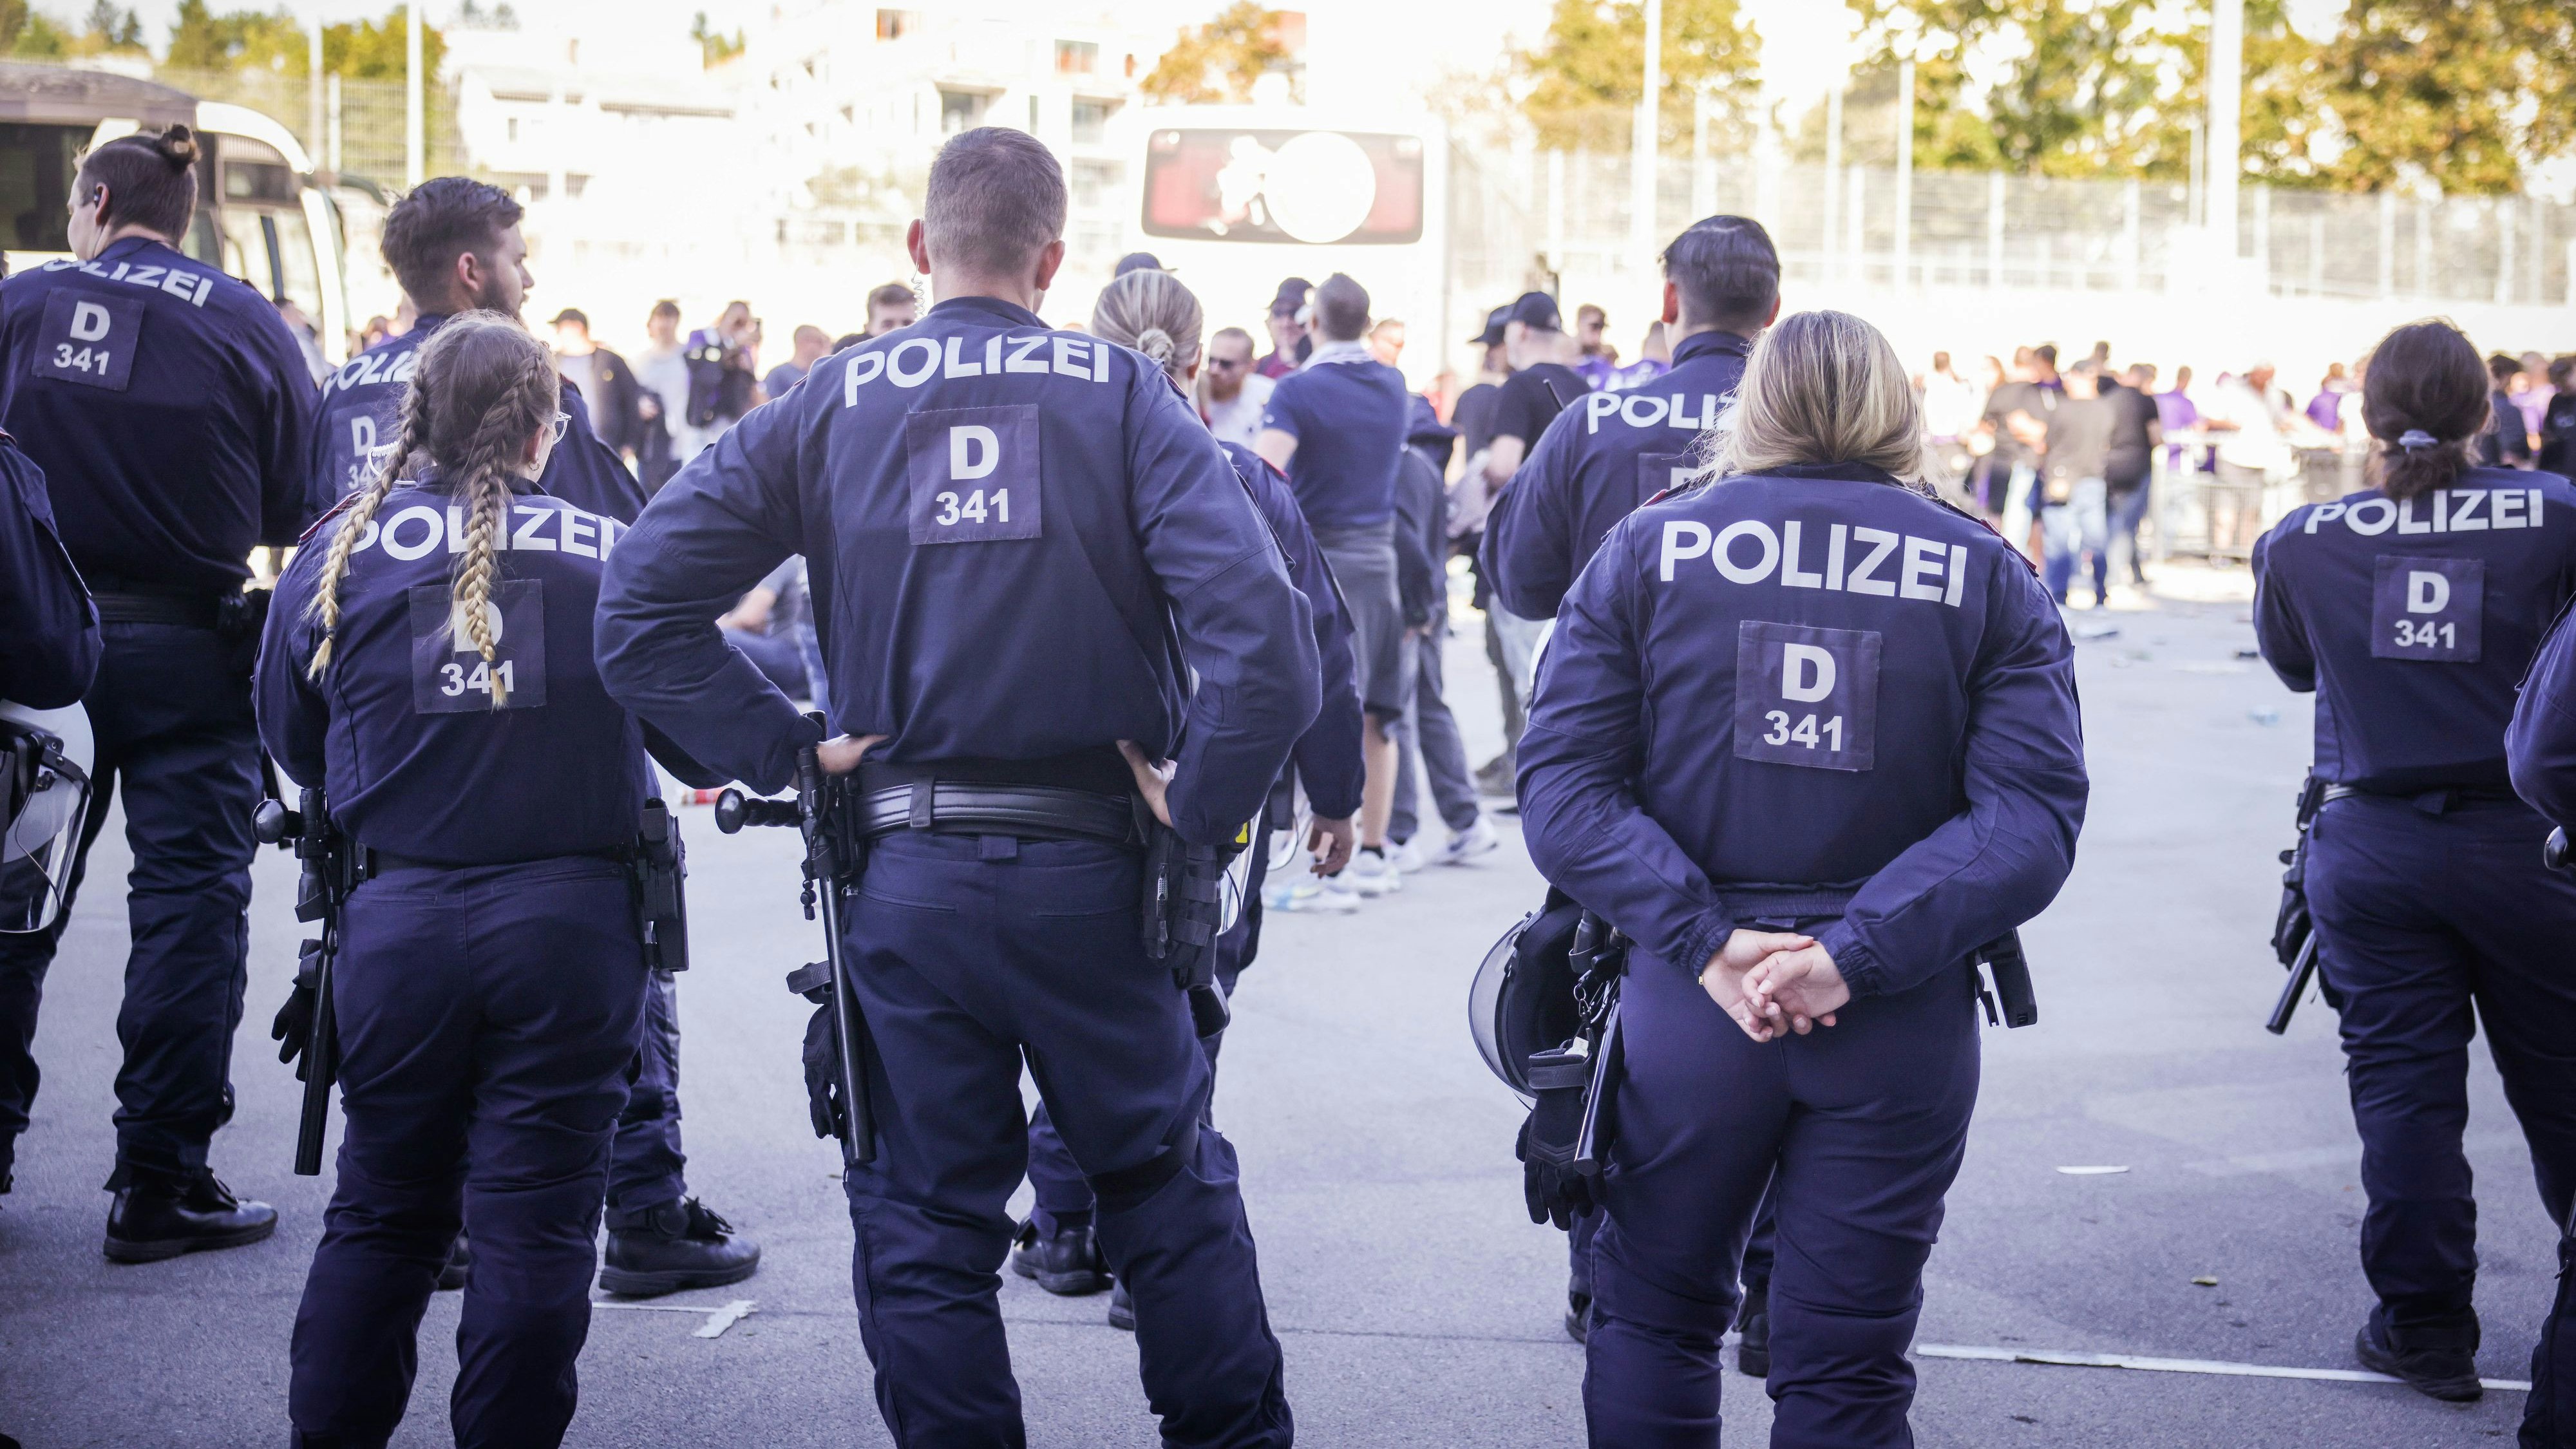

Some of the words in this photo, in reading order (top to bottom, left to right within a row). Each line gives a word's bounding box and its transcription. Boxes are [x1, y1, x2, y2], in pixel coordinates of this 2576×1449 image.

[7, 258, 213, 308] OLIZEI
[70, 301, 111, 341] D
[53, 343, 110, 375] 341
[844, 334, 1109, 408] POLIZEI
[351, 415, 376, 457] D
[950, 425, 1000, 480] D
[936, 488, 1009, 526] 341
[2304, 489, 2543, 536] POLIZEI
[1660, 520, 1967, 607] POLIZEI
[2407, 571, 2450, 614] D
[2394, 620, 2456, 649] 341
[440, 660, 514, 696] 341
[1782, 643, 1836, 703] D
[1763, 710, 1842, 752] 341
